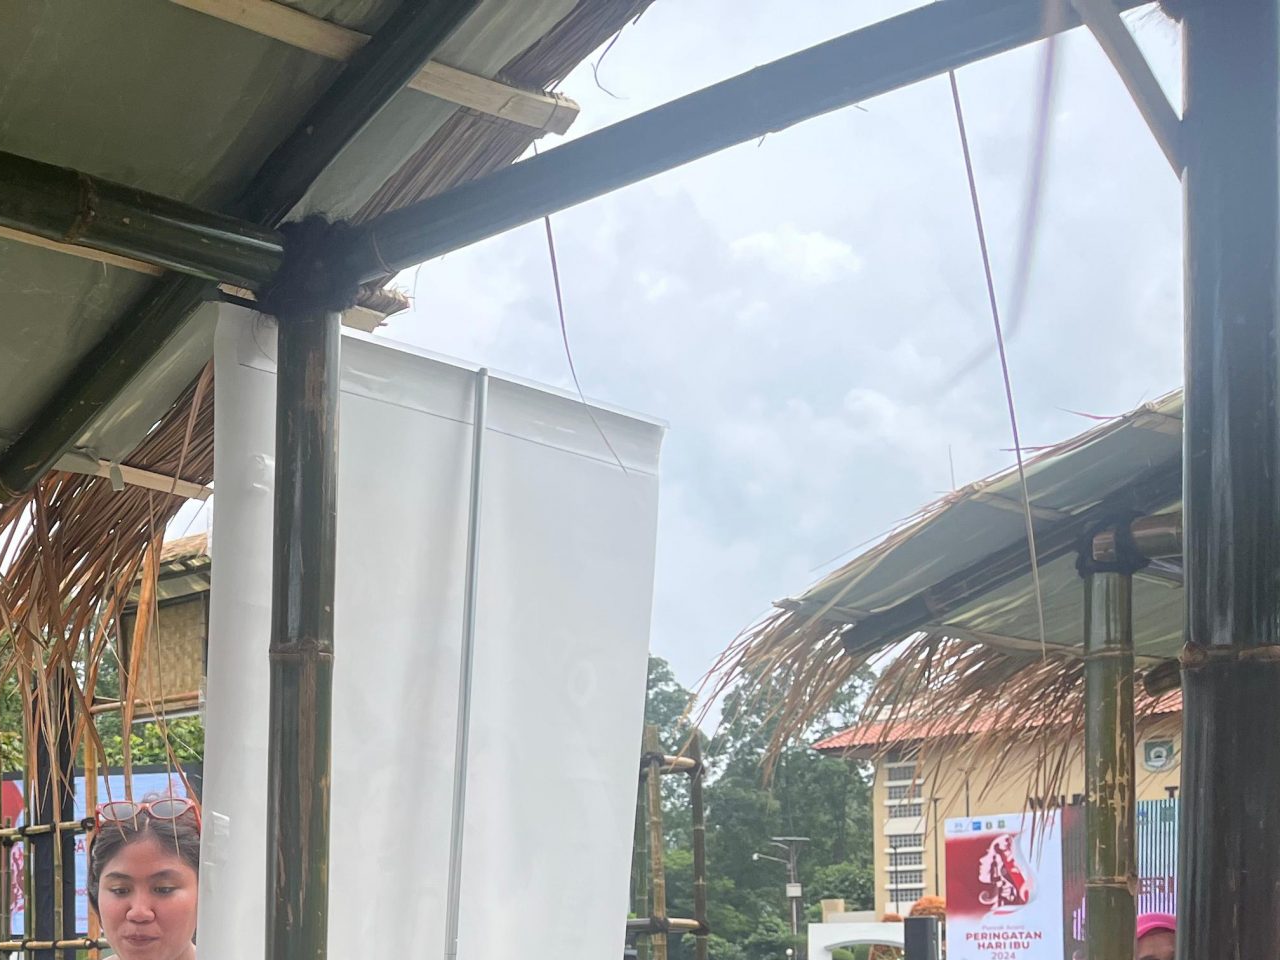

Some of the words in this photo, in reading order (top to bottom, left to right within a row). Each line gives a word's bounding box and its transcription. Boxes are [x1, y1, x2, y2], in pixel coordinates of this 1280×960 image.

[965, 931, 1042, 941] PERINGATAN
[977, 941, 1007, 950] HARI
[1009, 941, 1030, 950] IBU
[991, 952, 1016, 960] 2024
